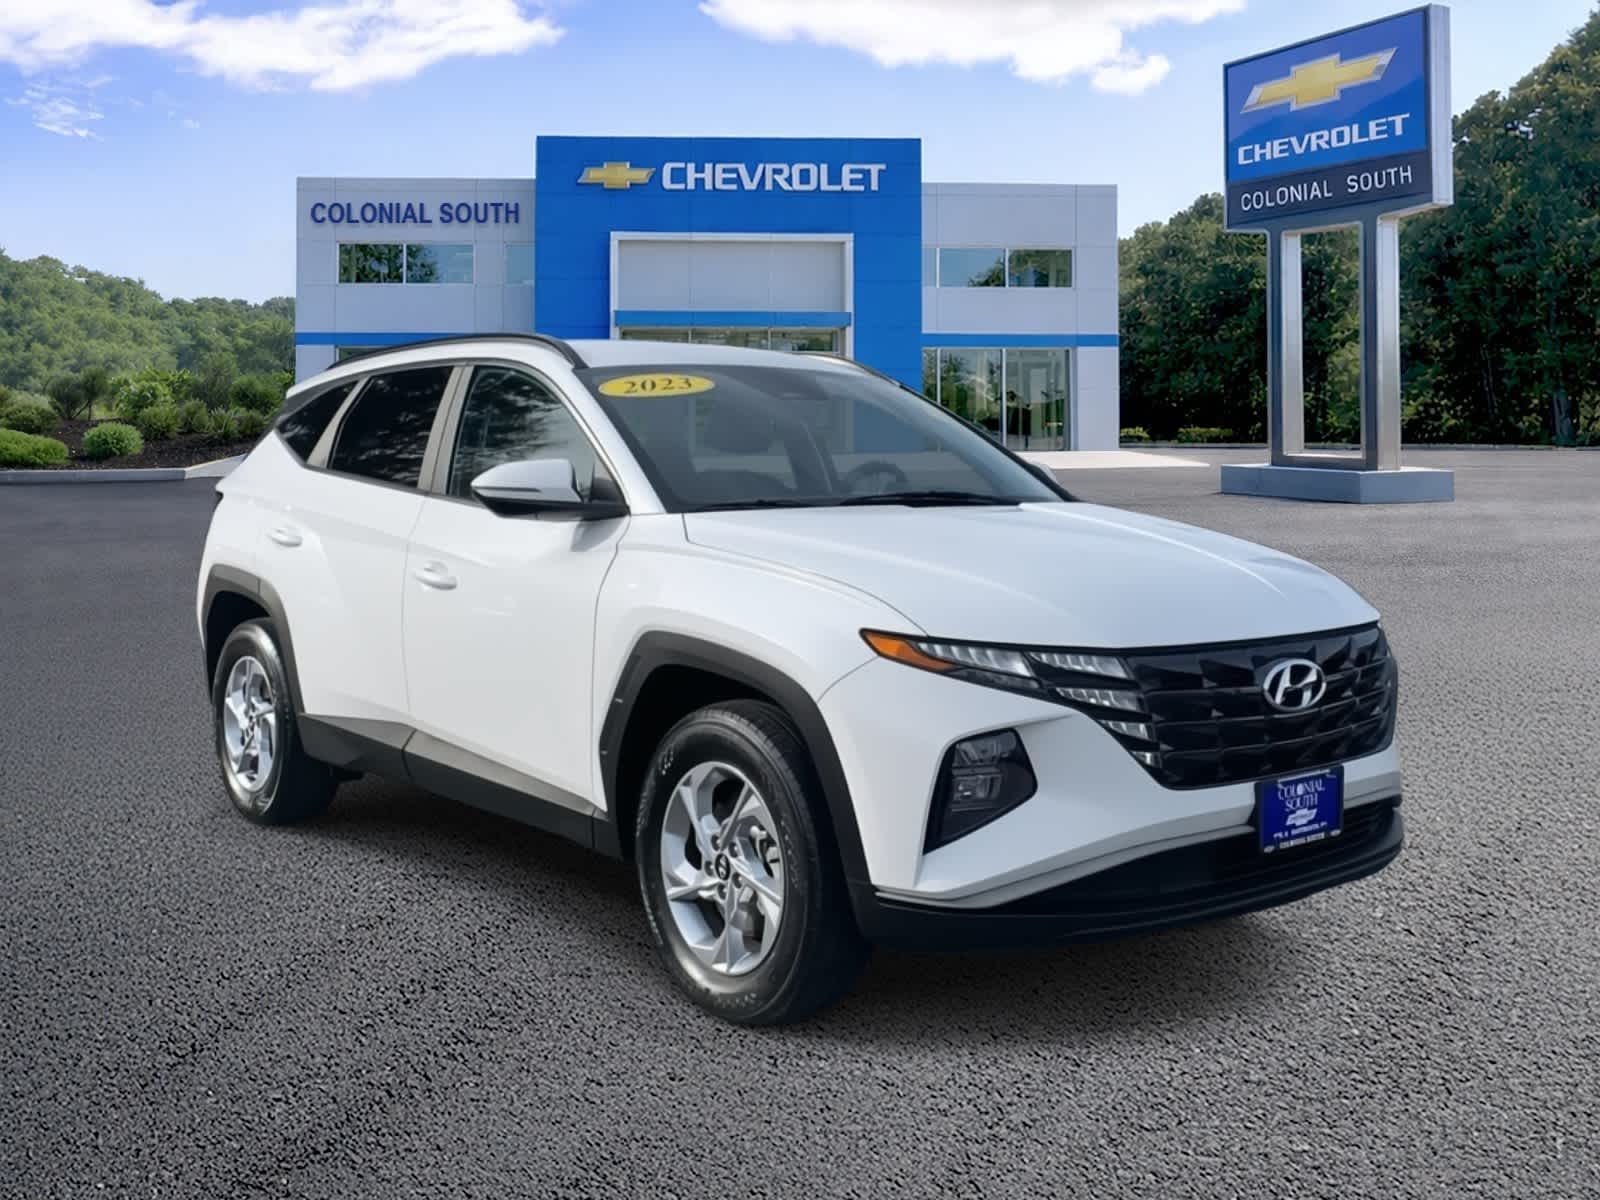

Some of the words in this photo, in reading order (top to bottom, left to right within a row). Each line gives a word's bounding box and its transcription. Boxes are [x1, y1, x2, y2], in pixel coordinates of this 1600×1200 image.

[1237, 113, 1410, 165] CHEVROLET
[661, 162, 887, 192] CHEVROLET
[1240, 180, 1333, 211] COLONIAL
[1346, 165, 1412, 193] SOUTH
[310, 202, 432, 224] COLONIAL
[439, 202, 520, 224] SOUTH
[623, 378, 692, 394] 2023
[1284, 793, 1318, 812] SOUTH
